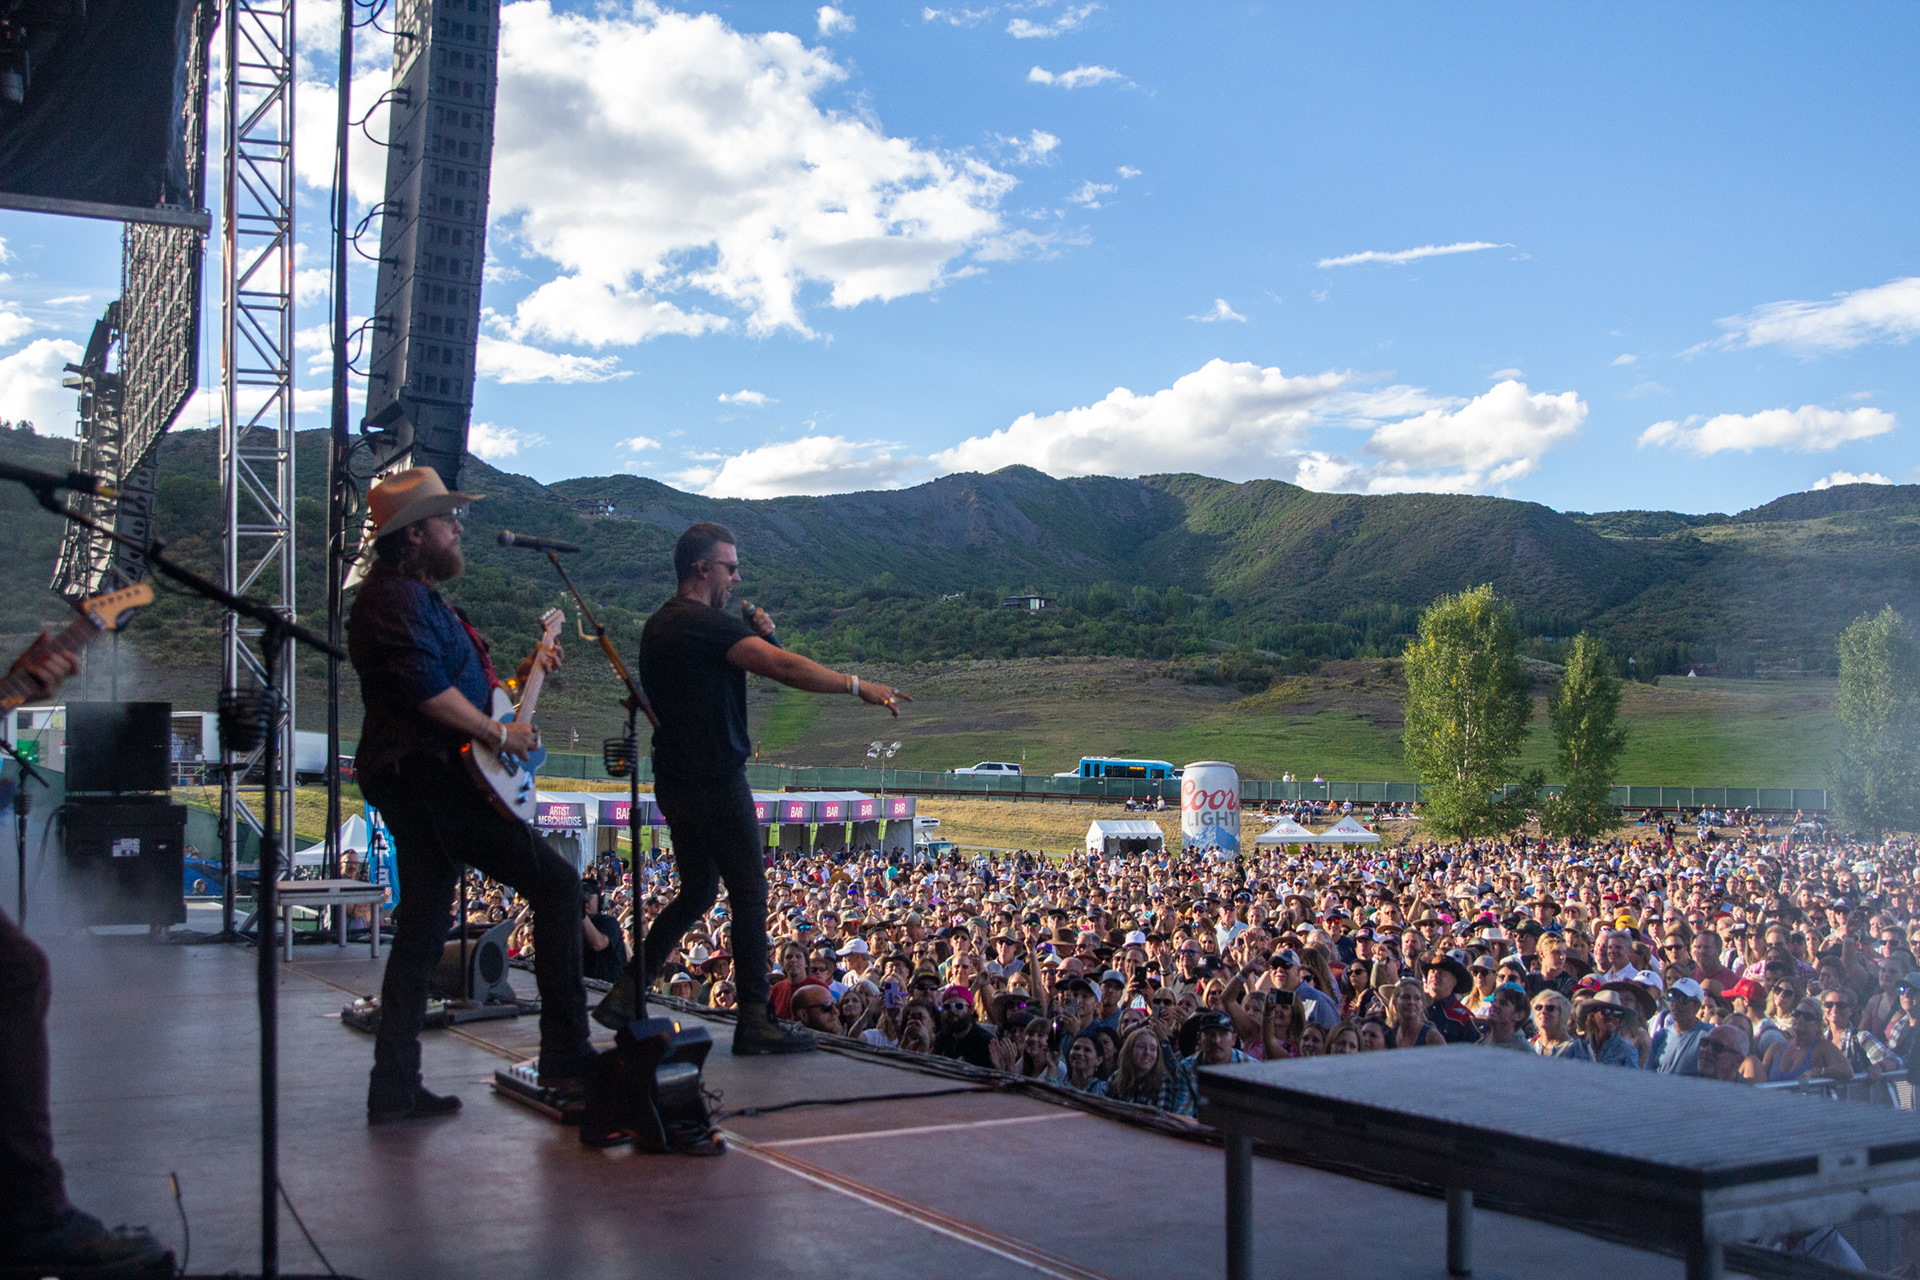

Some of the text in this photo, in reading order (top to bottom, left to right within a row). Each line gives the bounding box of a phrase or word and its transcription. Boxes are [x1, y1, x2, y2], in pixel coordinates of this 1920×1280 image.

[549, 806, 570, 816] ARTIST
[756, 807, 764, 818] AR
[790, 806, 803, 818] BAR
[826, 806, 839, 817] BAR
[861, 804, 873, 816] BAR
[894, 803, 906, 814] BAR
[538, 815, 582, 826] MERCHANDISE
[1187, 811, 1236, 826] LIGHT
